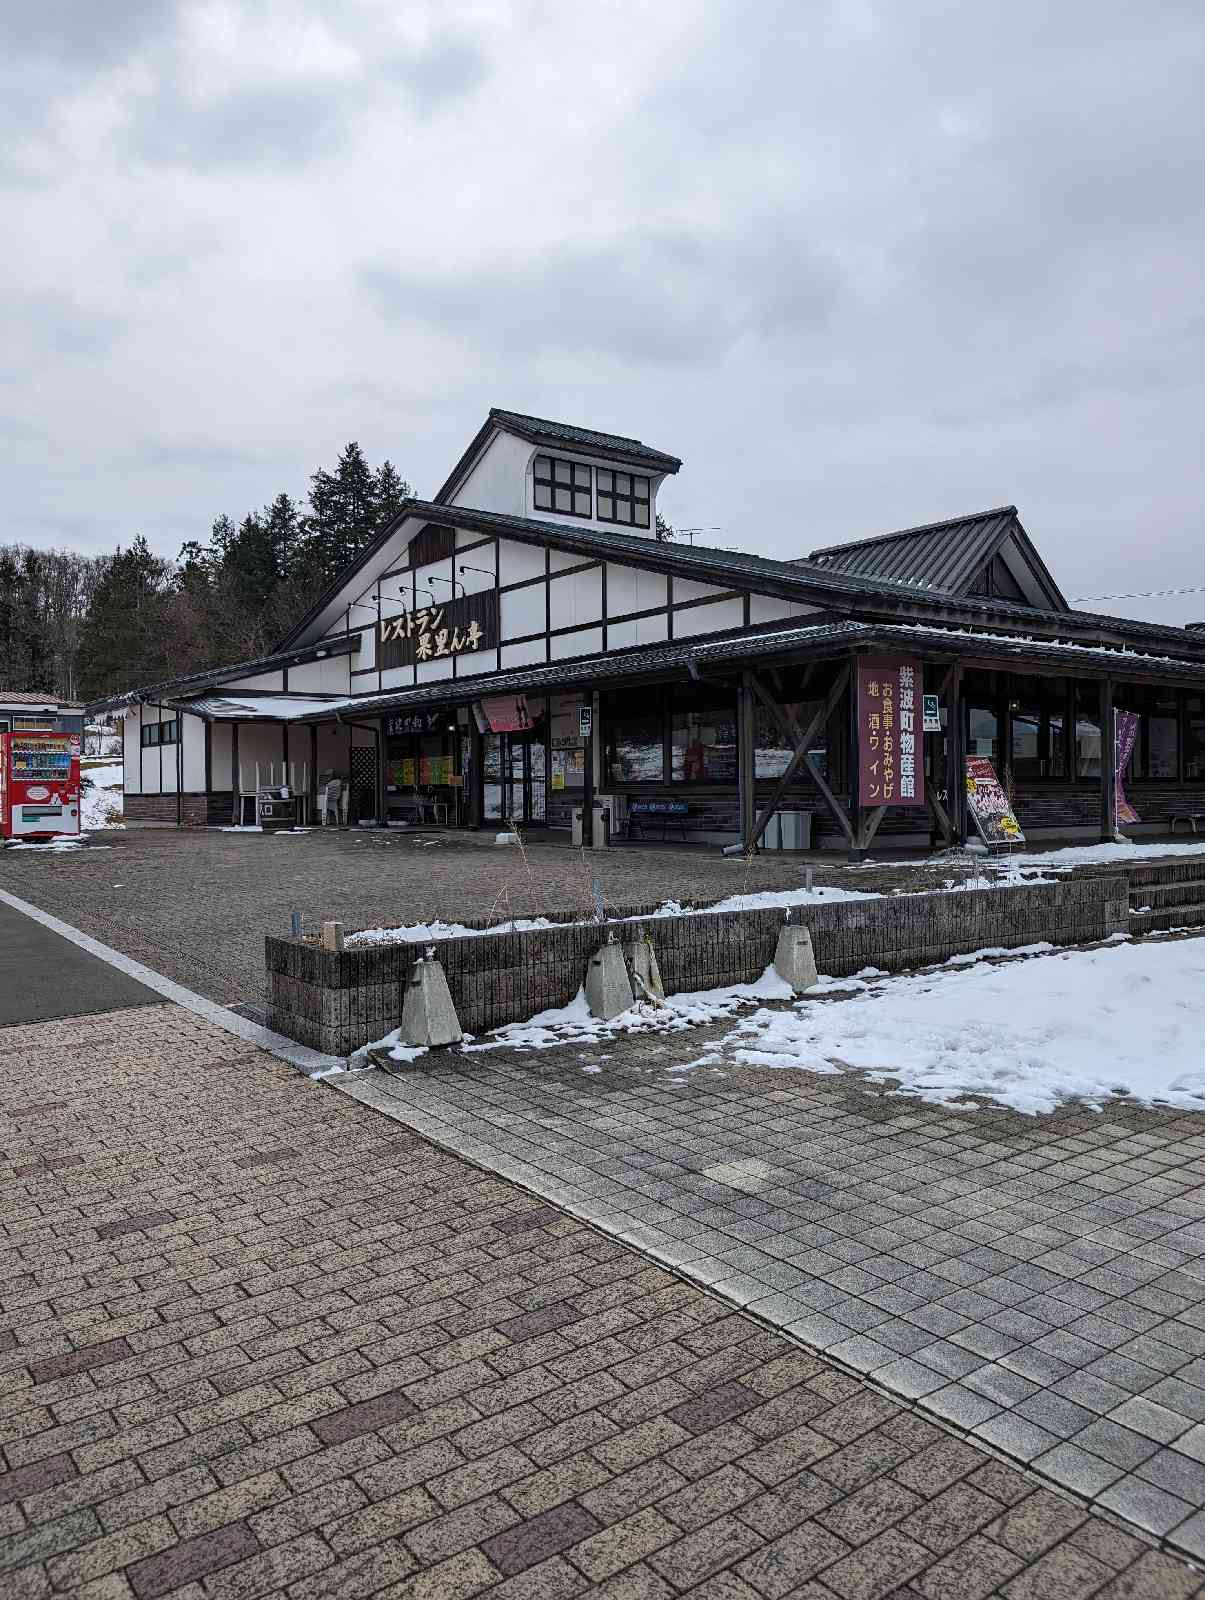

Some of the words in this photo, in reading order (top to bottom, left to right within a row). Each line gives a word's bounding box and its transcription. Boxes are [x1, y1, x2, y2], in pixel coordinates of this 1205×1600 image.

[381, 608, 444, 642] レストラン
[882, 682, 894, 799] お食事・おみやげ
[899, 666, 915, 799] 紫波町物産館
